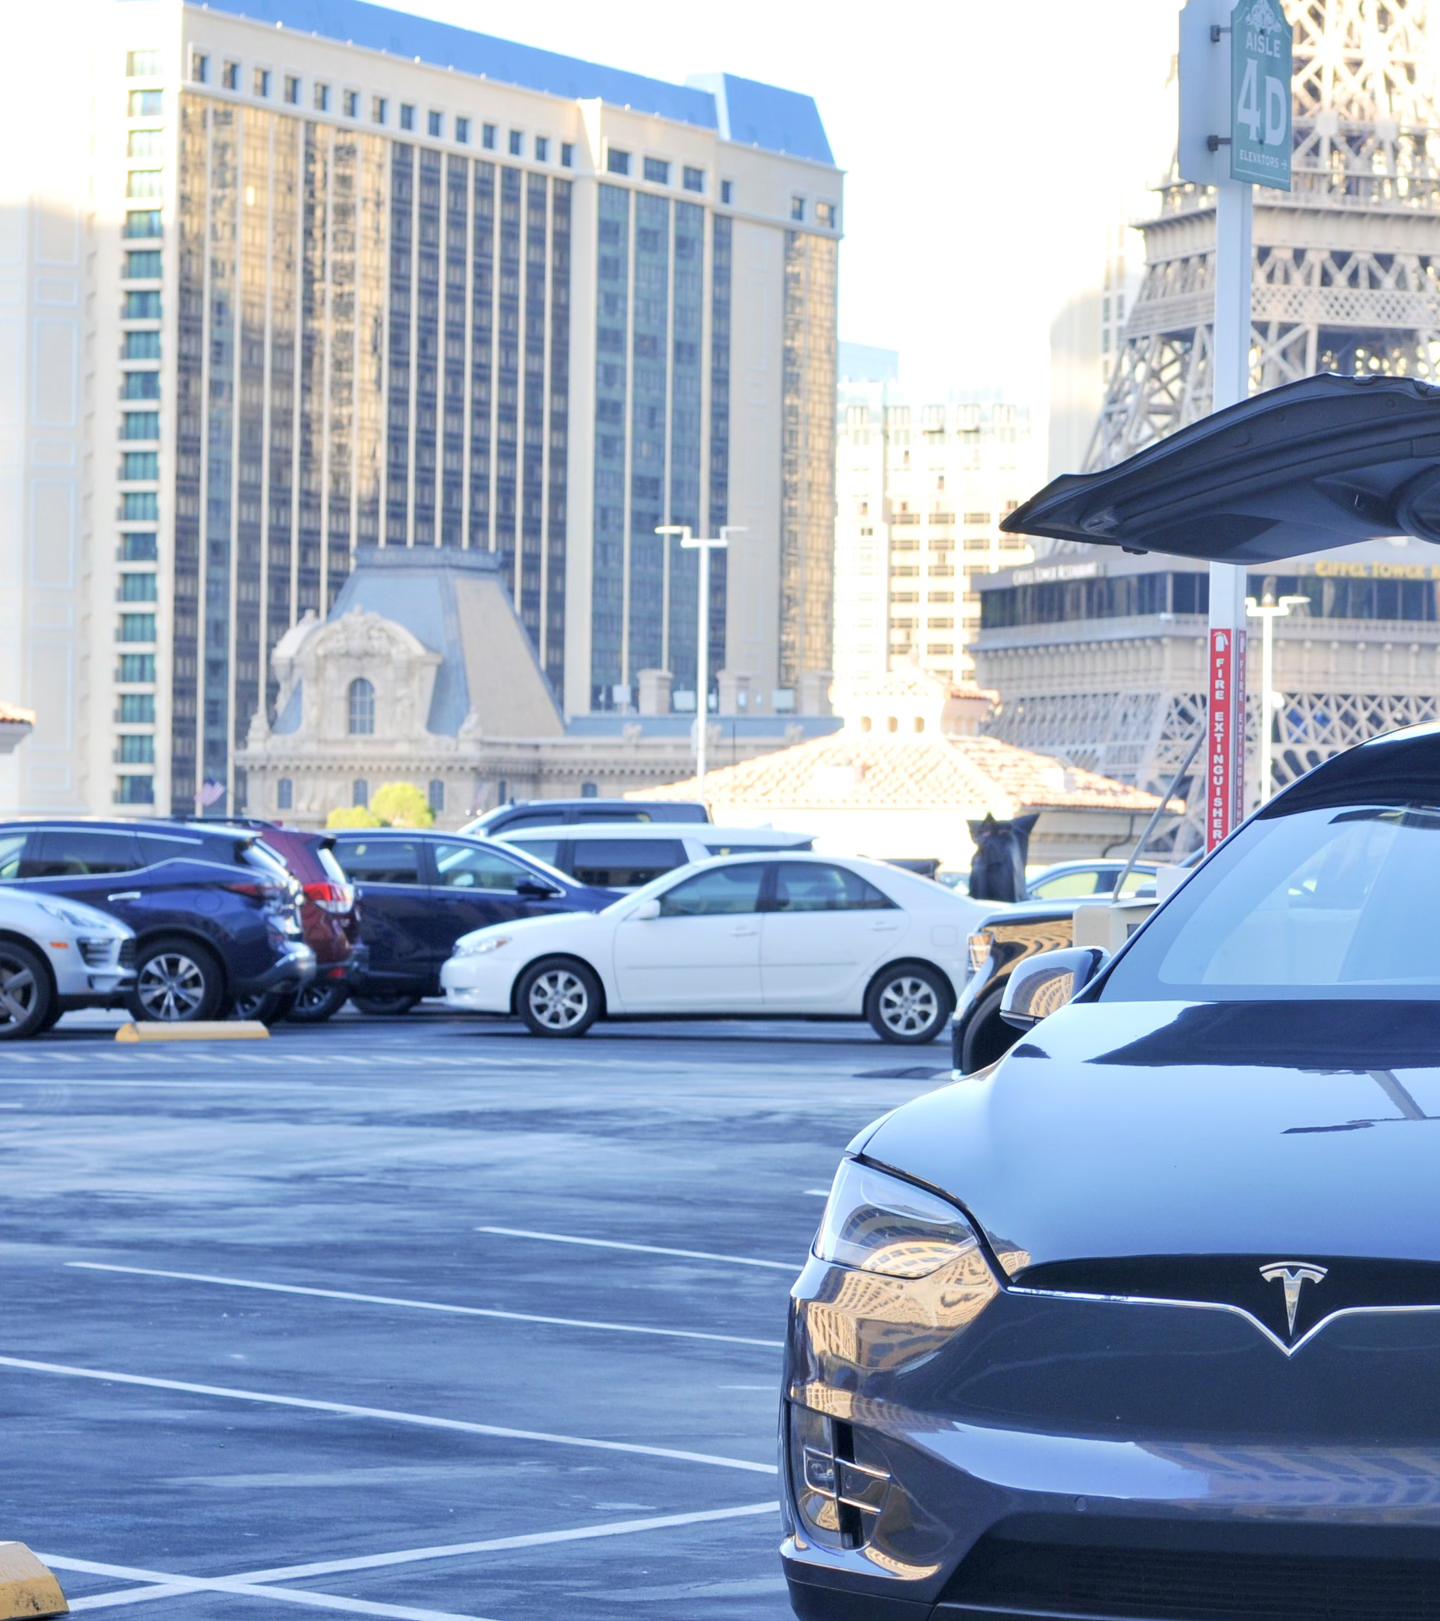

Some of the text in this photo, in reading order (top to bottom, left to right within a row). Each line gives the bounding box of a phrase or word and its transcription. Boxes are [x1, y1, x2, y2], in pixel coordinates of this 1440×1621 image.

[1245, 33, 1281, 58] AISLE
[1237, 58, 1287, 146] 4D
[1239, 149, 1280, 169] ELEVATORS
[1212, 658, 1225, 840] FIRE EXTINGUISHER
